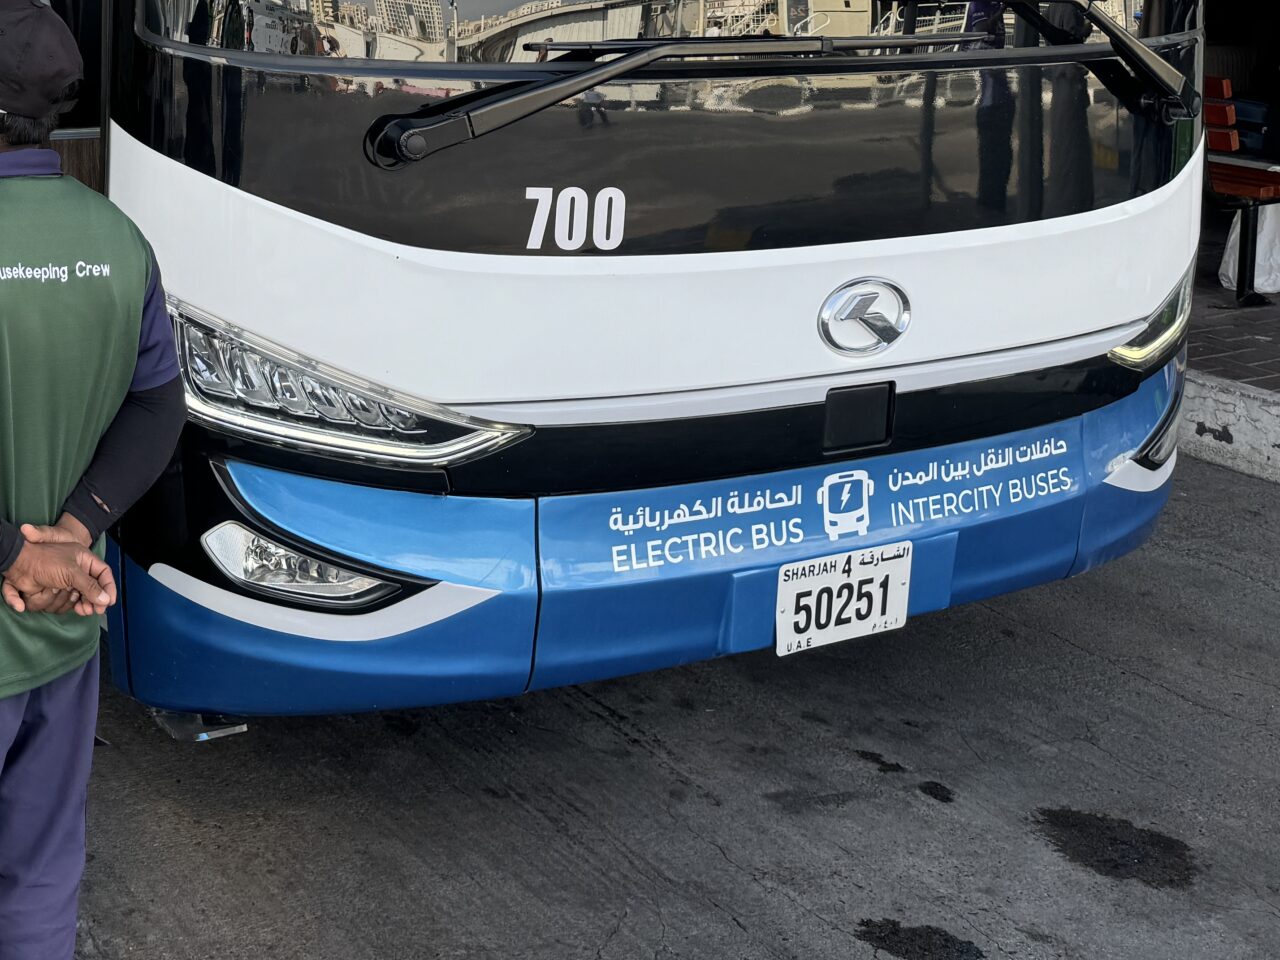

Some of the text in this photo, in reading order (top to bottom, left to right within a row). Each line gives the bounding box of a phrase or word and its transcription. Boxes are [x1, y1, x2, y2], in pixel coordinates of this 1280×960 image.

[525, 186, 625, 251] 700
[75, 260, 110, 278] Crew
[888, 437, 1067, 493] حافلات النقل بين المدن
[608, 484, 802, 539] الحافلة الكهربائية
[890, 467, 1072, 528] INTERCITY BUSES
[611, 517, 804, 573] ELECTRIC BUS
[783, 554, 853, 583] SHARJAH 4
[859, 546, 910, 567] الشارقة
[793, 573, 890, 635] 50251
